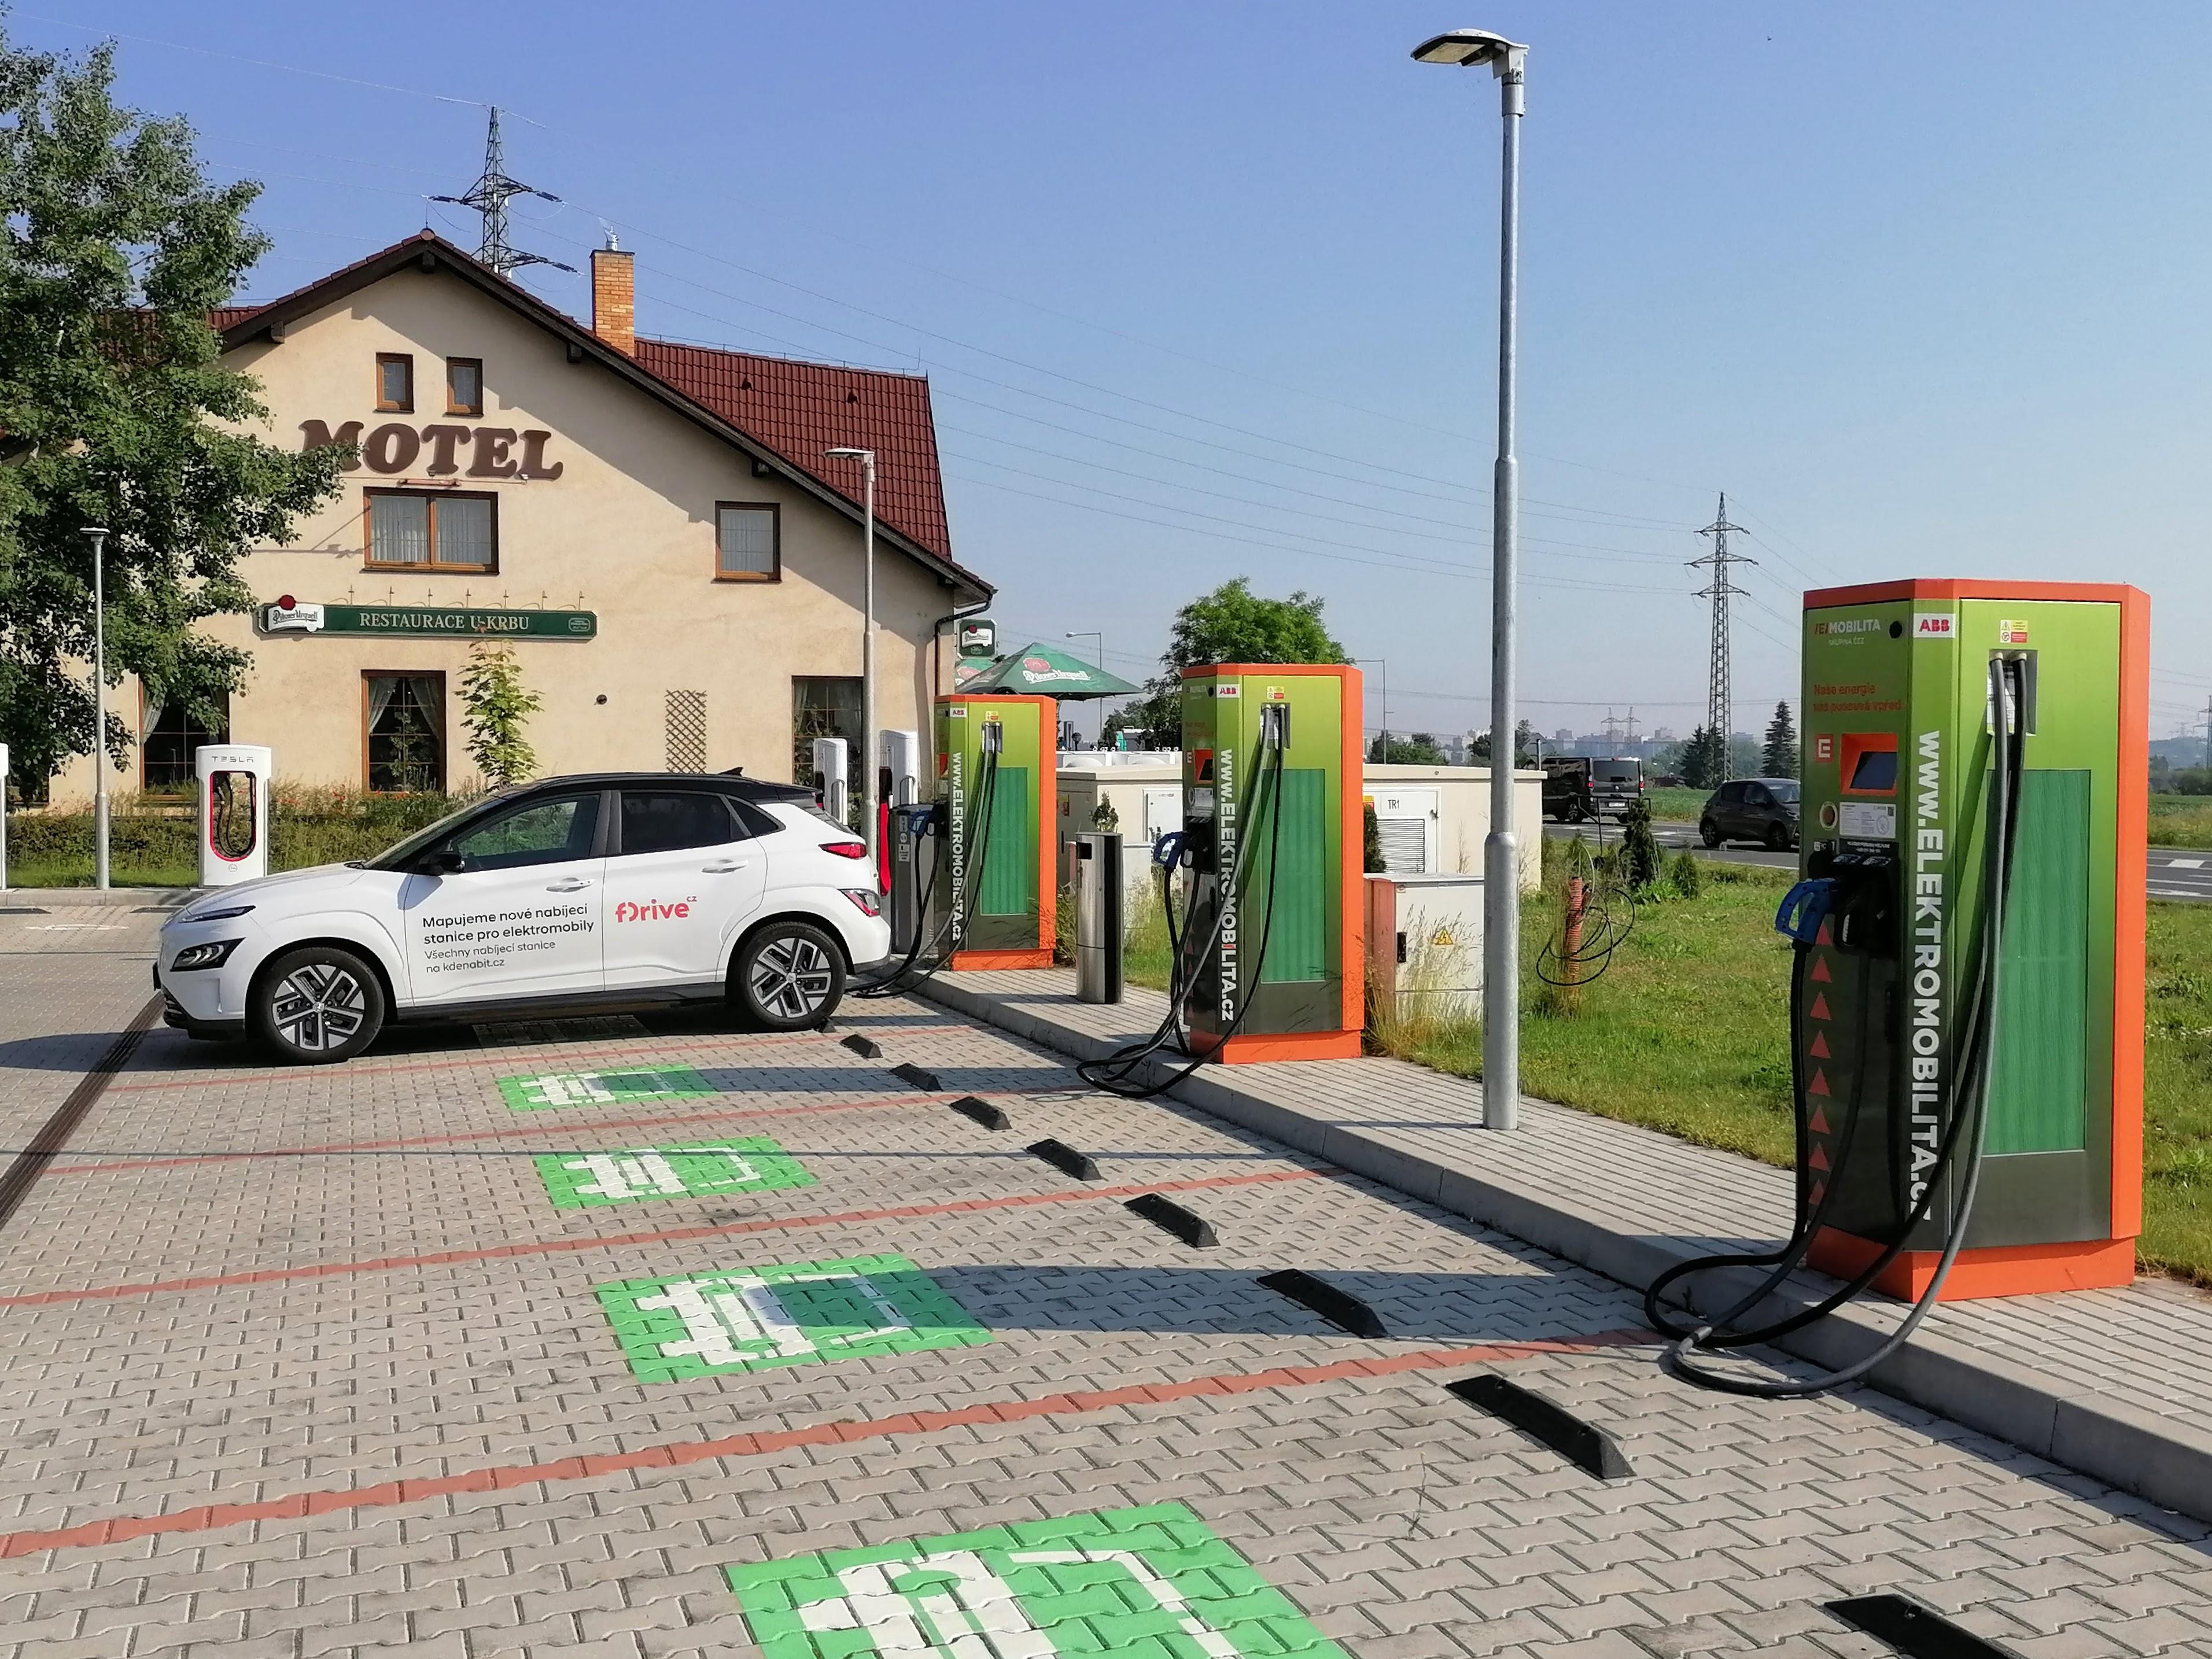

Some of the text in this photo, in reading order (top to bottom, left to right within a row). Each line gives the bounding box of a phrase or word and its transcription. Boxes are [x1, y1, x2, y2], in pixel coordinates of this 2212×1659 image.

[298, 419, 563, 481] MOTEL
[359, 613, 529, 630] RESTAURACE U KRBU
[1919, 619, 1949, 632] ABB
[1219, 687, 1237, 695] ABB
[1388, 799, 1400, 809] TR1
[423, 904, 587, 928] Mapujeme nové nabíjecí
[424, 920, 594, 945] stanice pro elektromobily
[425, 941, 556, 960] Všechny nabíjecí stanice
[443, 958, 505, 971] kdenabit.cz
